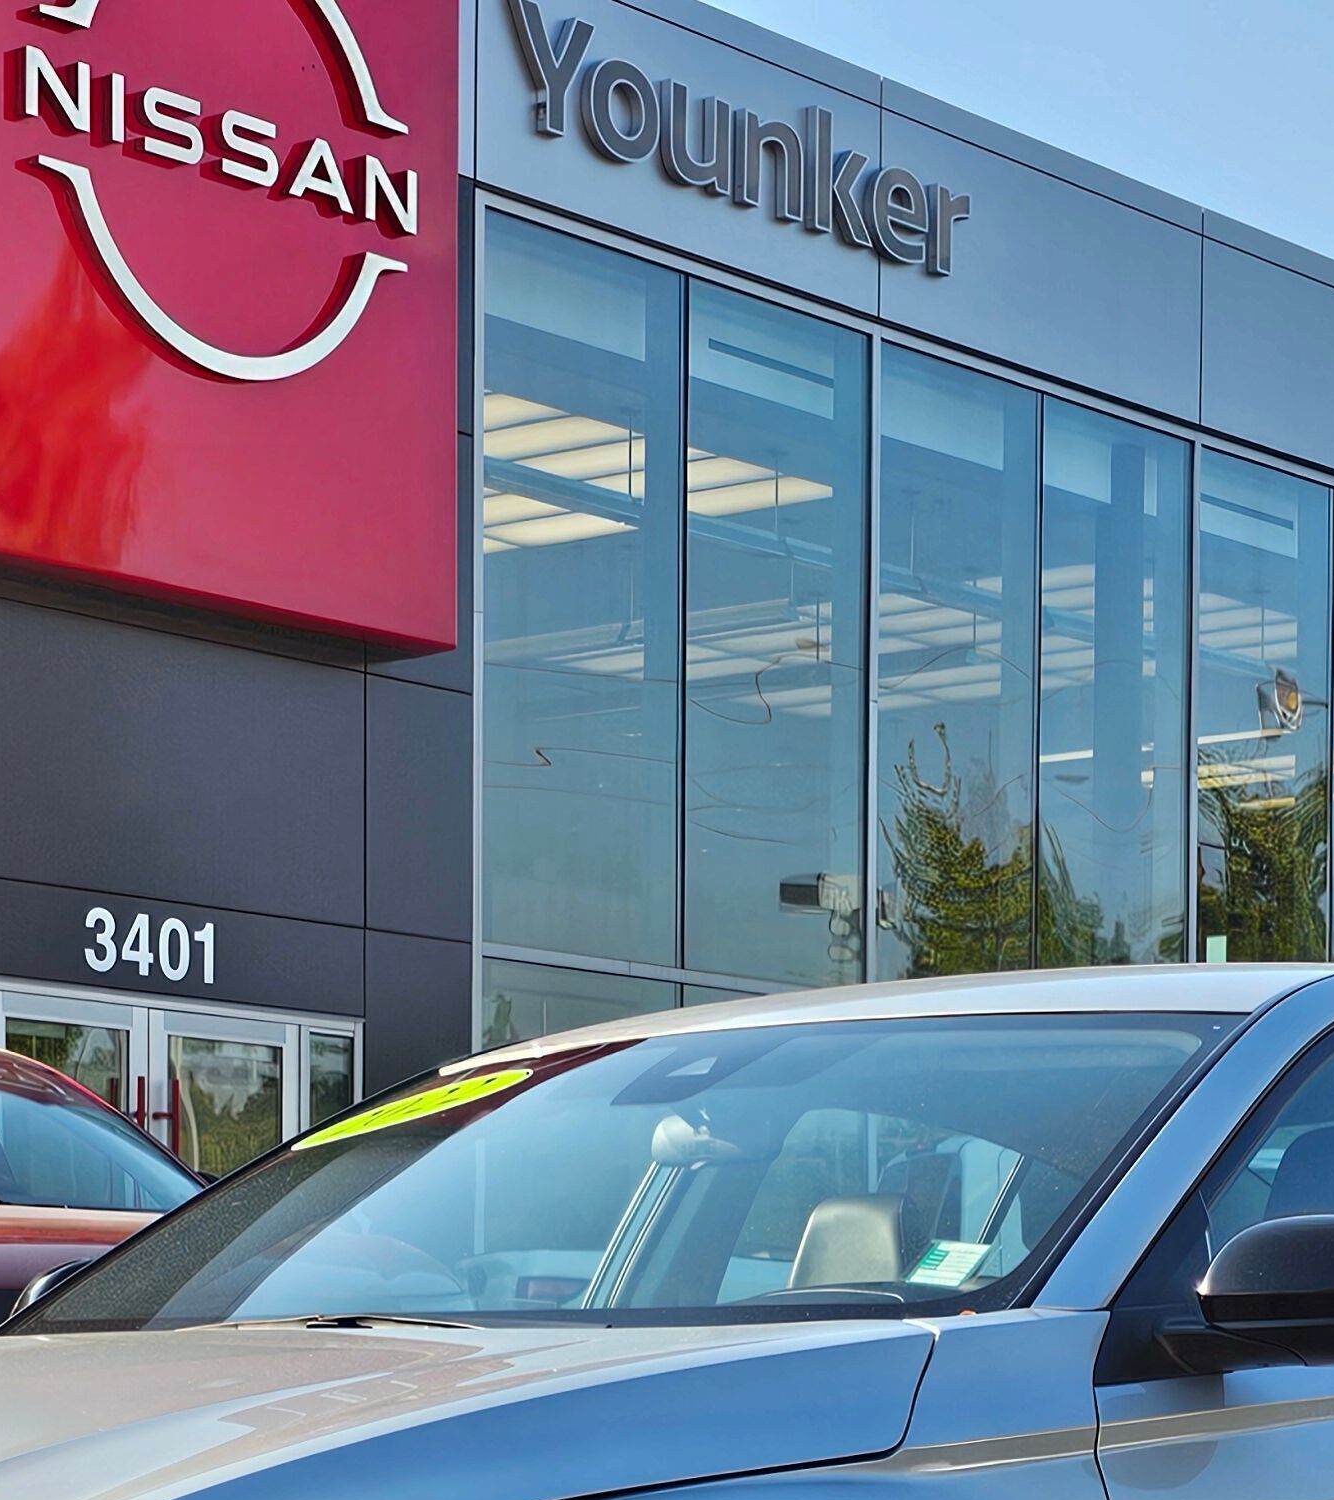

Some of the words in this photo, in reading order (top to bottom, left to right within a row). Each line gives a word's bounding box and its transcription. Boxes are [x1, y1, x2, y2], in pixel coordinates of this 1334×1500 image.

[23, 44, 418, 236] NISSAN
[509, 0, 971, 276] Younker
[84, 907, 215, 984] 3401
